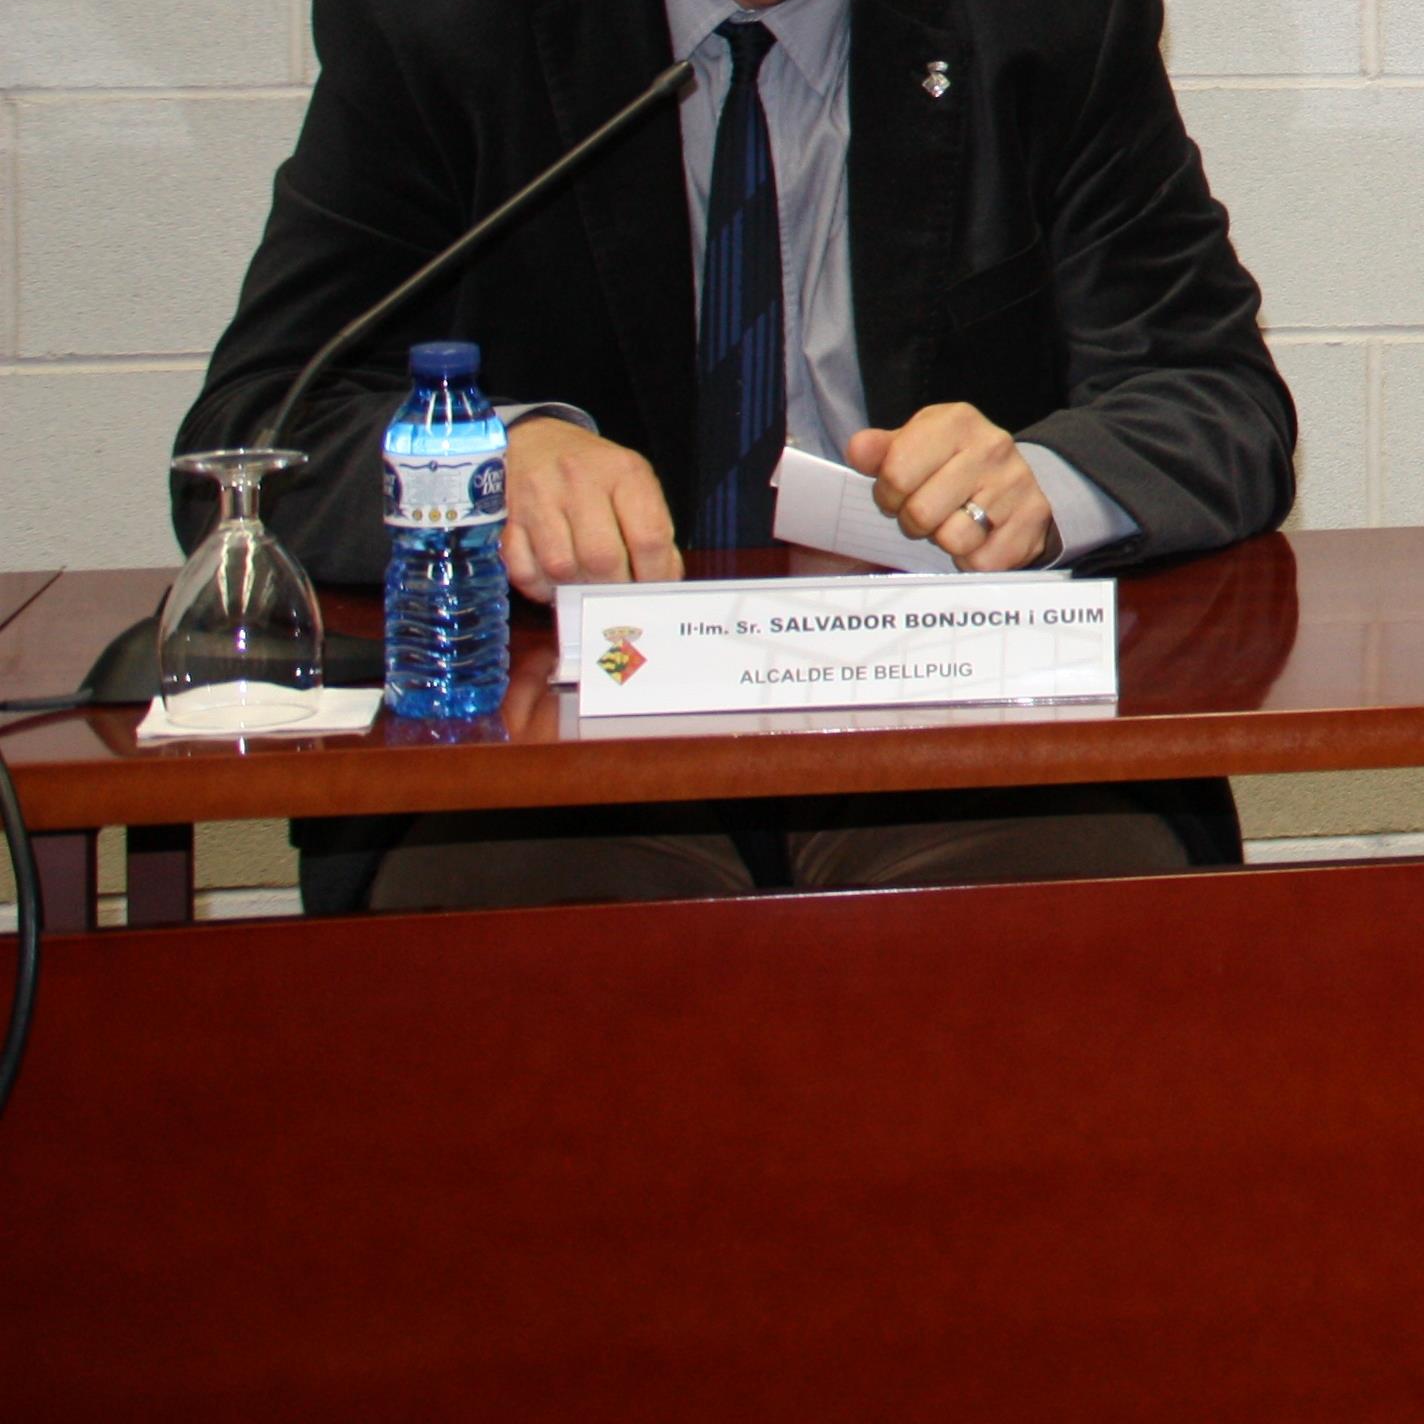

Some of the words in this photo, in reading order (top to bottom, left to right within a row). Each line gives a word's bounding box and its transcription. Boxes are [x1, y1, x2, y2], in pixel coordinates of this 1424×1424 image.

[736, 621, 761, 634] Sr.
[770, 614, 896, 633] SALVADOR
[905, 610, 1020, 629] BONJOCH
[1029, 610, 1035, 625] i
[1043, 607, 1104, 625] GUIM
[740, 667, 834, 684] ALCALDE
[841, 665, 868, 681] DE
[874, 662, 973, 680] BELLPUIG
